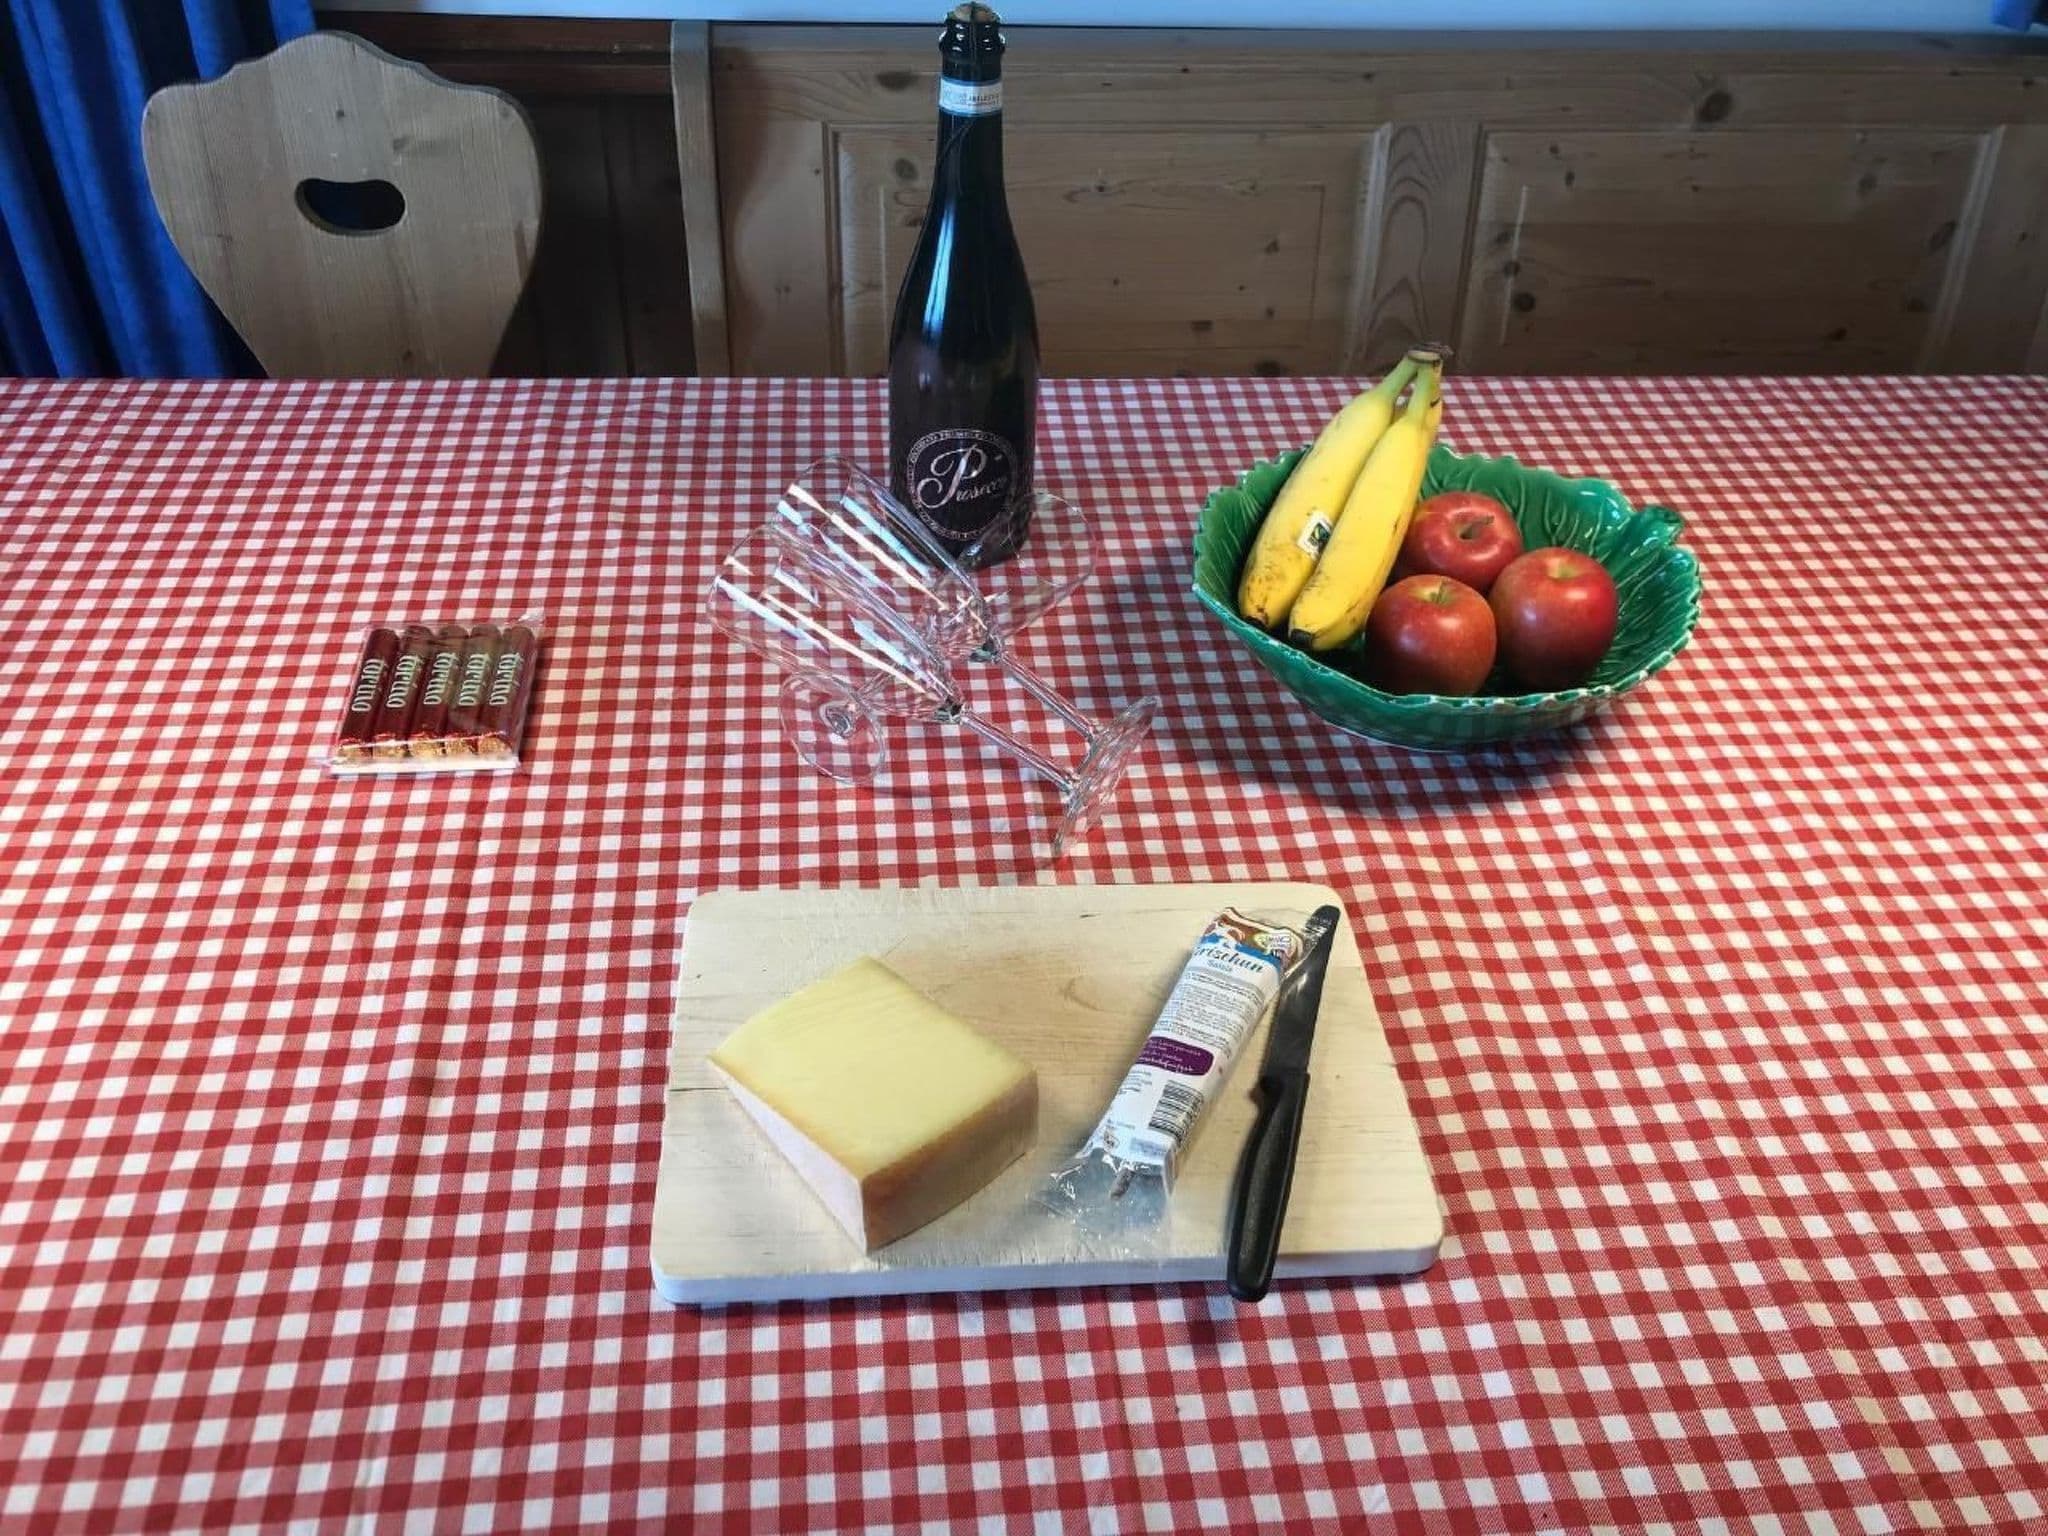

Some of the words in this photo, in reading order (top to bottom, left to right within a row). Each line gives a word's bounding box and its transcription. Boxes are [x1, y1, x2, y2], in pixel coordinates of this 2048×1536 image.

[351, 658, 388, 712] torino
[386, 654, 423, 708] torino
[423, 651, 460, 705] torino
[458, 652, 491, 706] torino
[489, 651, 523, 705] torino
[1193, 946, 1264, 973] rischun
